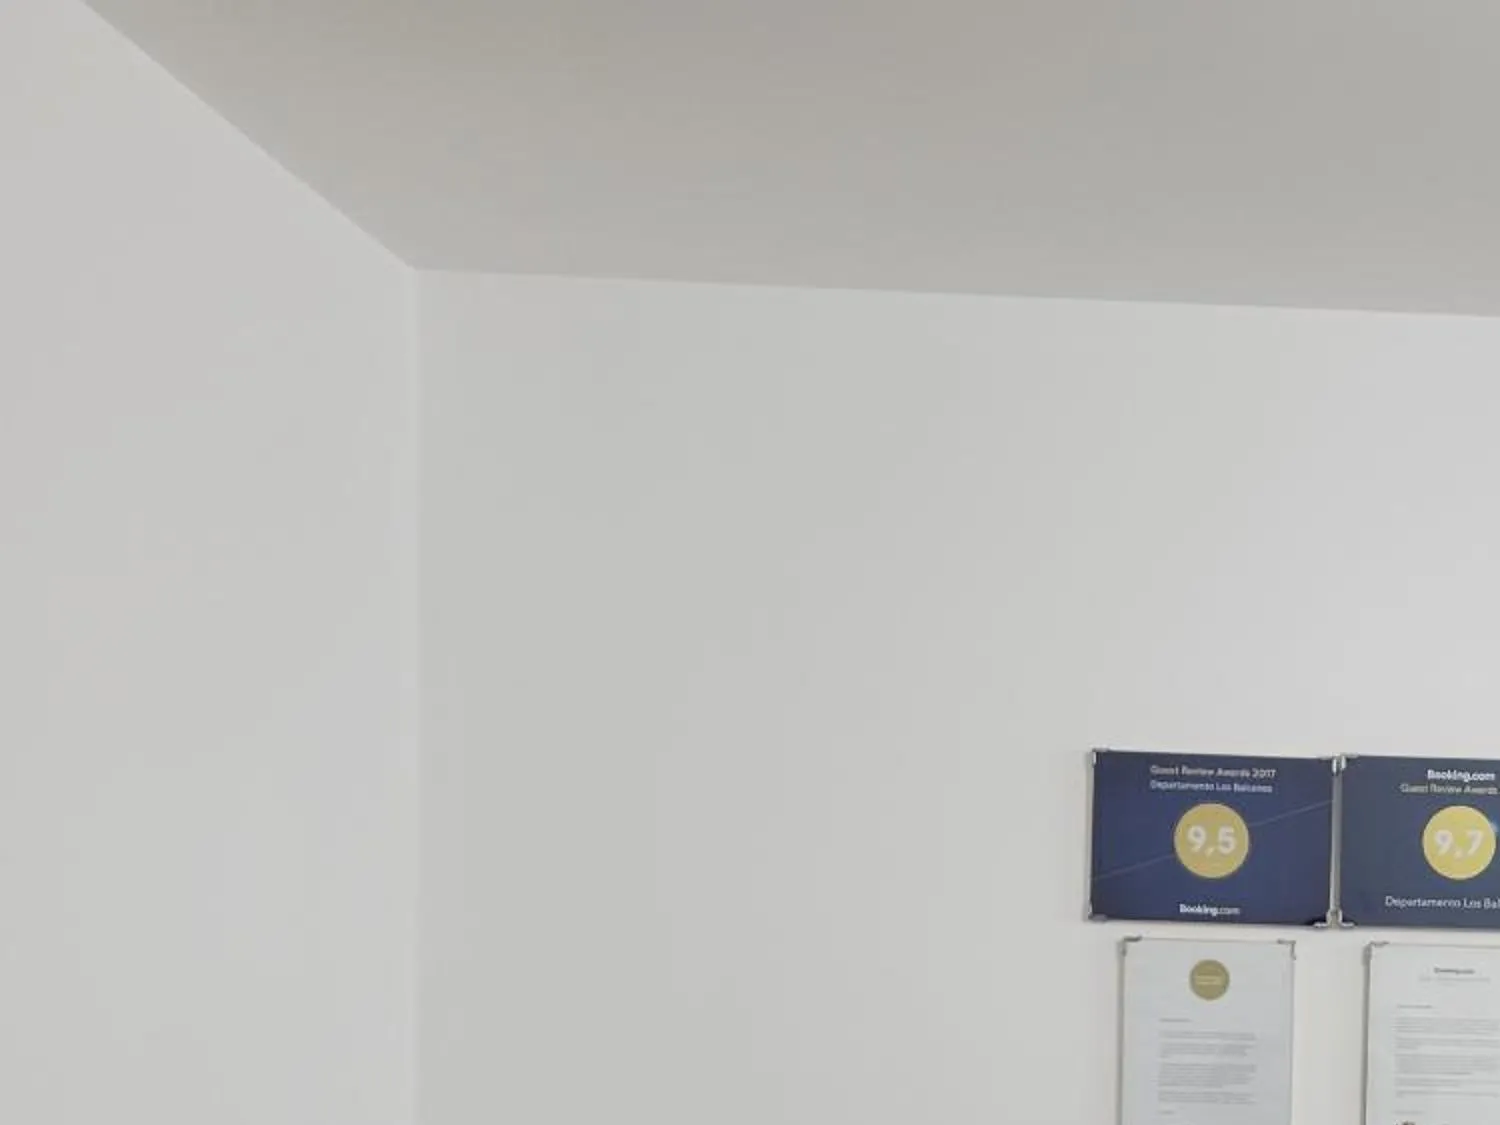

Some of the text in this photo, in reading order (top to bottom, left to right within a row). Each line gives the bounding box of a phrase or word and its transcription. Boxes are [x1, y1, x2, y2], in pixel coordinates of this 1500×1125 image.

[1149, 765, 1277, 779] Guest Review Awards 2017
[1426, 769, 1496, 783] Booking.com
[1149, 779, 1215, 793] Departamento
[1430, 783, 1463, 794] Review
[1463, 784, 1499, 796] Awards
[1187, 825, 1237, 858] 9,5
[1434, 828, 1484, 860] 9,7
[1385, 895, 1461, 910] Departamento
[1463, 897, 1482, 909] Los
[1179, 903, 1241, 917] Booking.com
